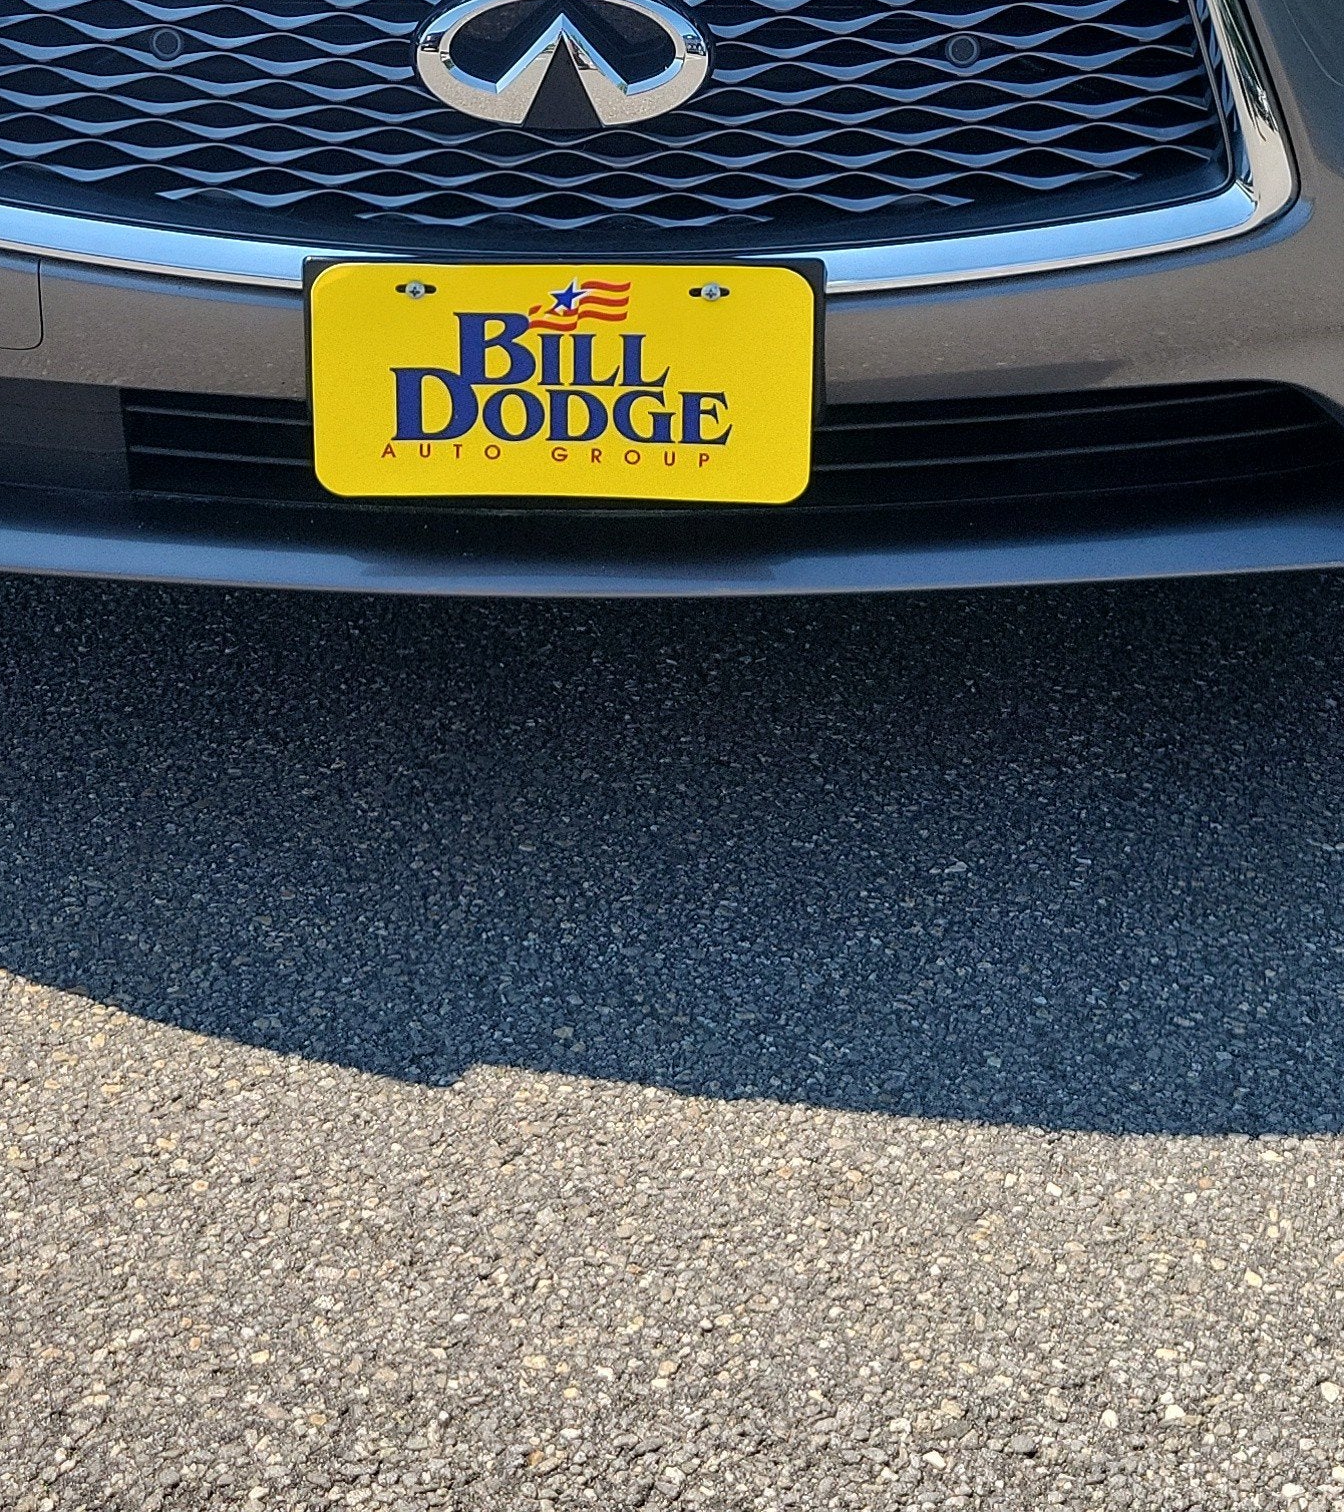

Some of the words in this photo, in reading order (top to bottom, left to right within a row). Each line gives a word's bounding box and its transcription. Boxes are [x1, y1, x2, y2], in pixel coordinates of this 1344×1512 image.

[453, 312, 670, 388] BILL
[389, 366, 733, 446] DODGE
[380, 443, 503, 462] AUTO
[550, 445, 712, 468] GROUP
